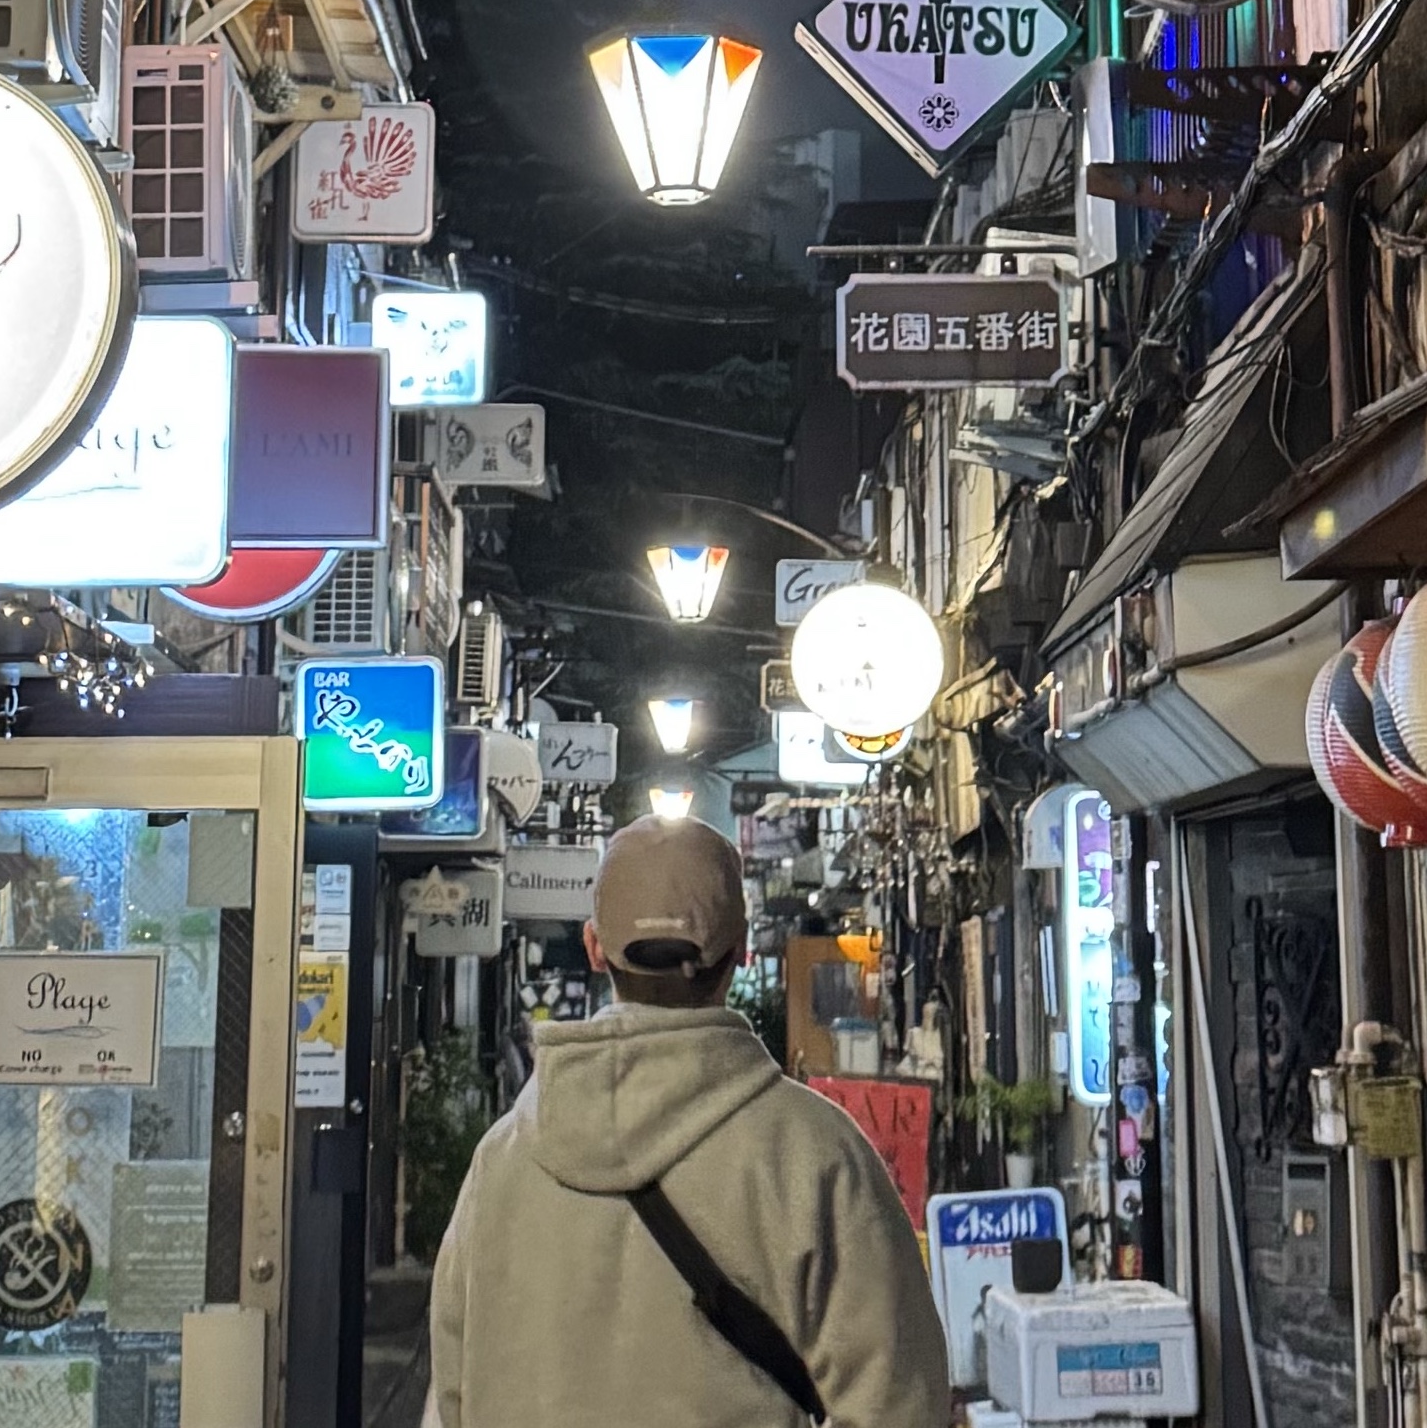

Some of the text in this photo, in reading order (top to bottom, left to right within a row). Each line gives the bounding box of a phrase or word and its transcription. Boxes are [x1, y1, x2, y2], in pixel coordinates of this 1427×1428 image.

[842, 1, 1038, 58] UKATSU
[849, 309, 1058, 355] 花園五番街
[314, 671, 350, 688] BAR
[428, 897, 490, 928] 湖
[27, 972, 111, 1026] Plage
[21, 1050, 42, 1062] NO
[97, 1049, 116, 1062] OK
[951, 1198, 1038, 1243] Asahi
